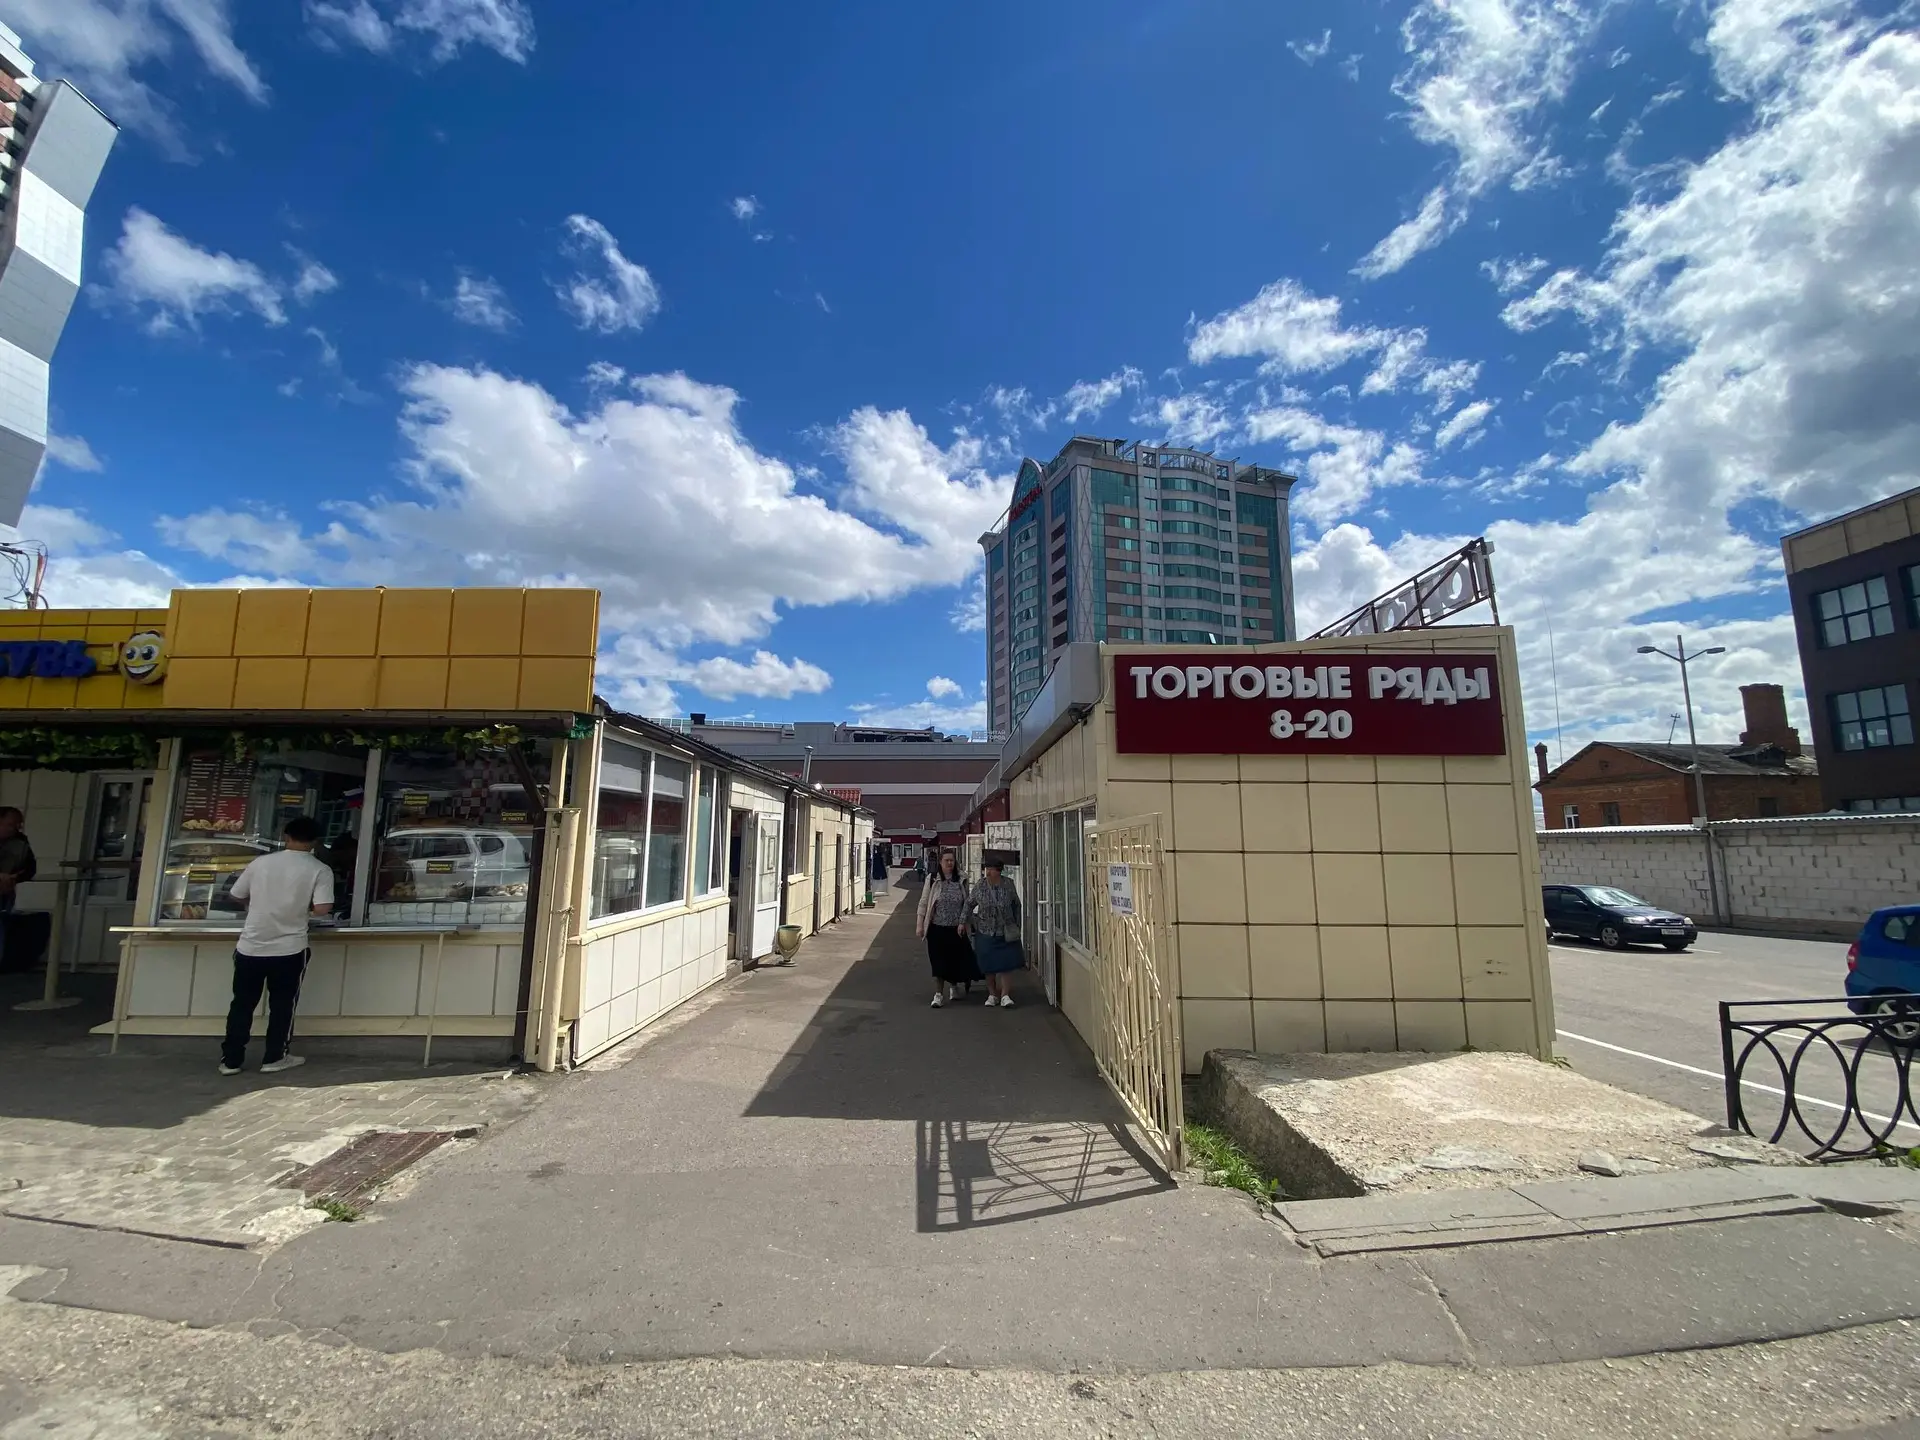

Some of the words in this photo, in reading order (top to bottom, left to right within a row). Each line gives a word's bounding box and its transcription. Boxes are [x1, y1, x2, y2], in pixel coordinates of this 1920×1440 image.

[1130, 666, 1352, 699] ТОРГОВЫЕ
[1368, 667, 1490, 704] РЯДЫ
[1270, 709, 1353, 739] 8-20
